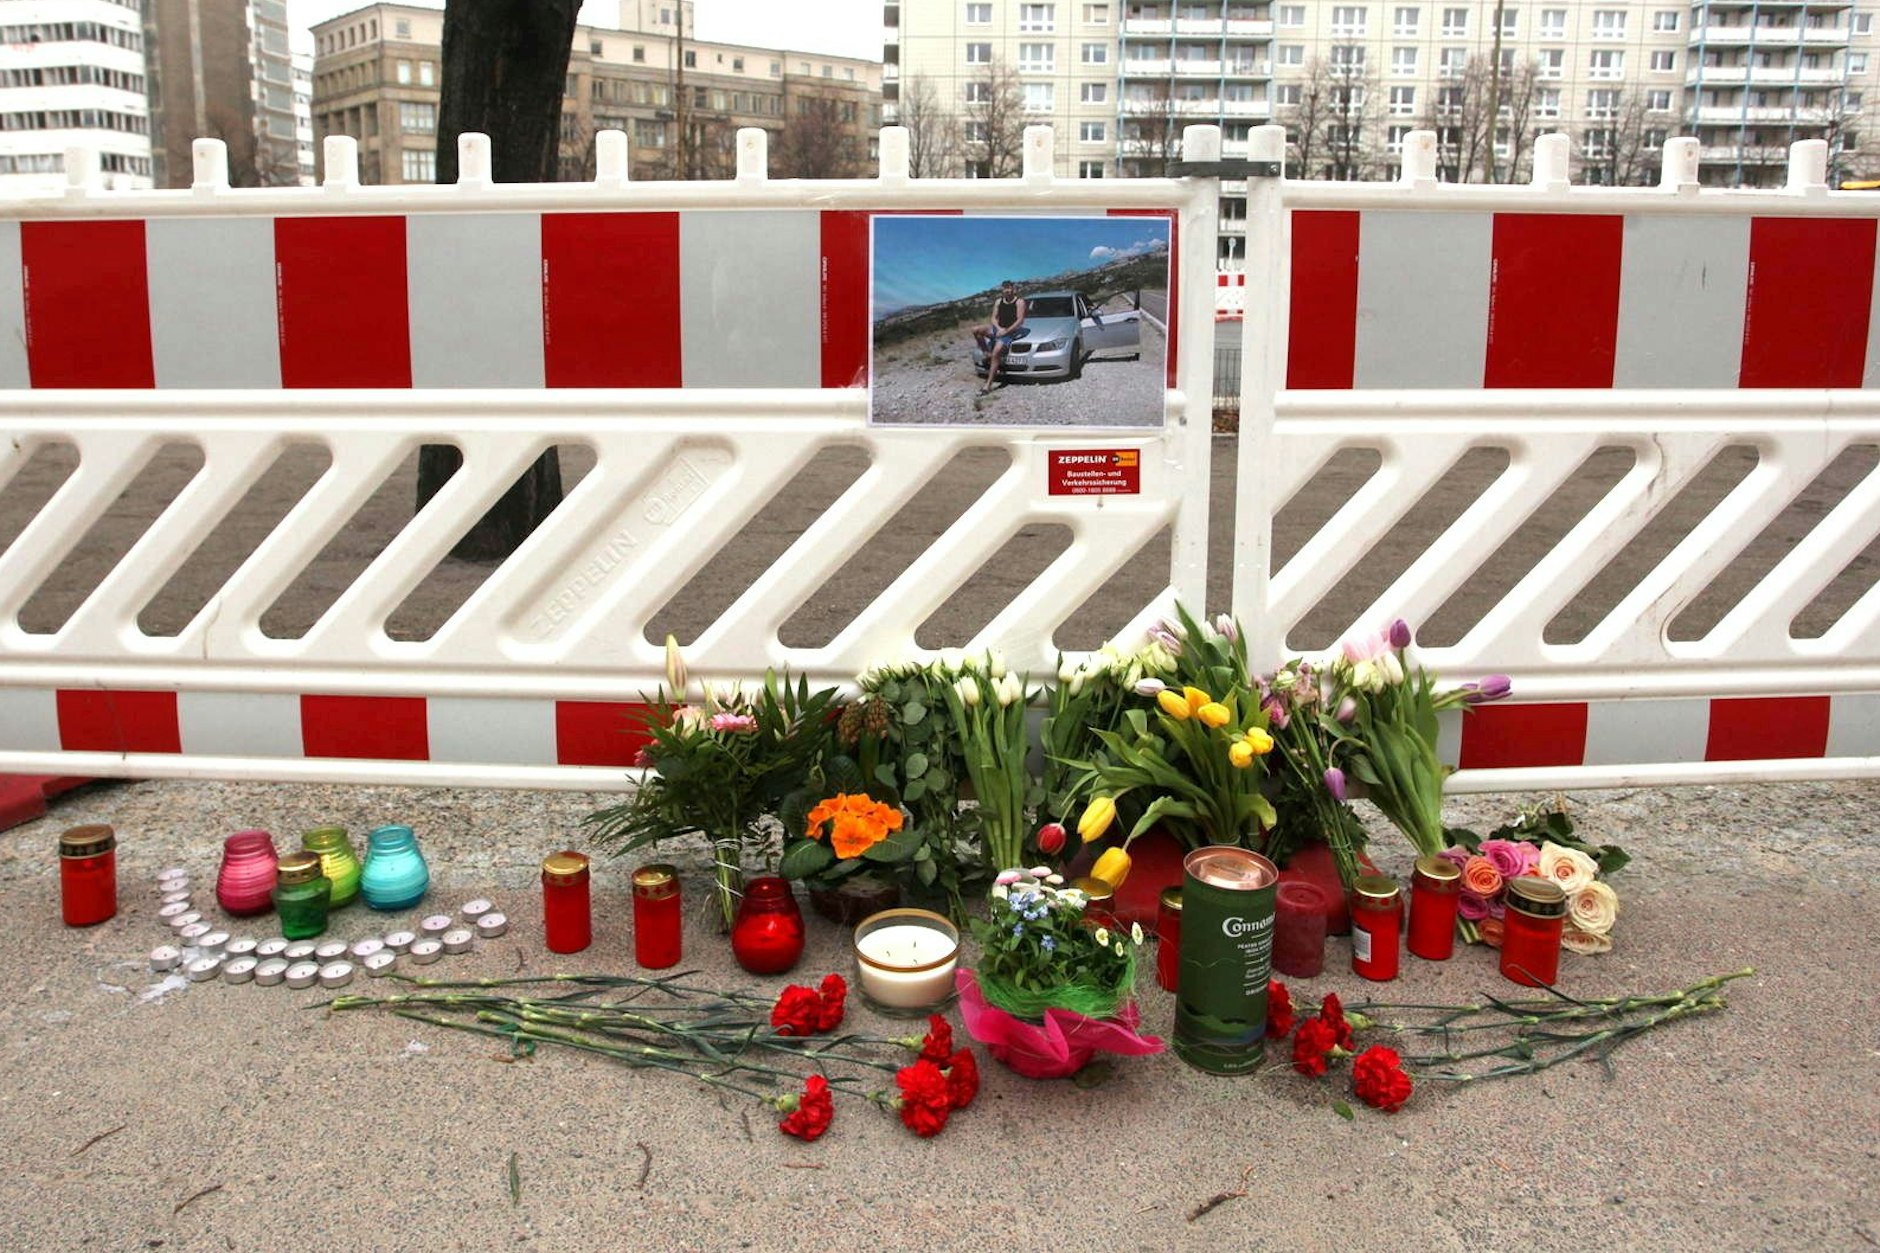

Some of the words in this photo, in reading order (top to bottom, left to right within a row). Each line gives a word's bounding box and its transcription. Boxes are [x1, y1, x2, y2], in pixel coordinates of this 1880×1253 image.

[1058, 455, 1107, 464] ZEPPELIN
[1066, 470, 1106, 478] Baustellen-
[1062, 479, 1127, 487] Verkehrssicherung
[531, 529, 638, 638] ZEPPELIN
